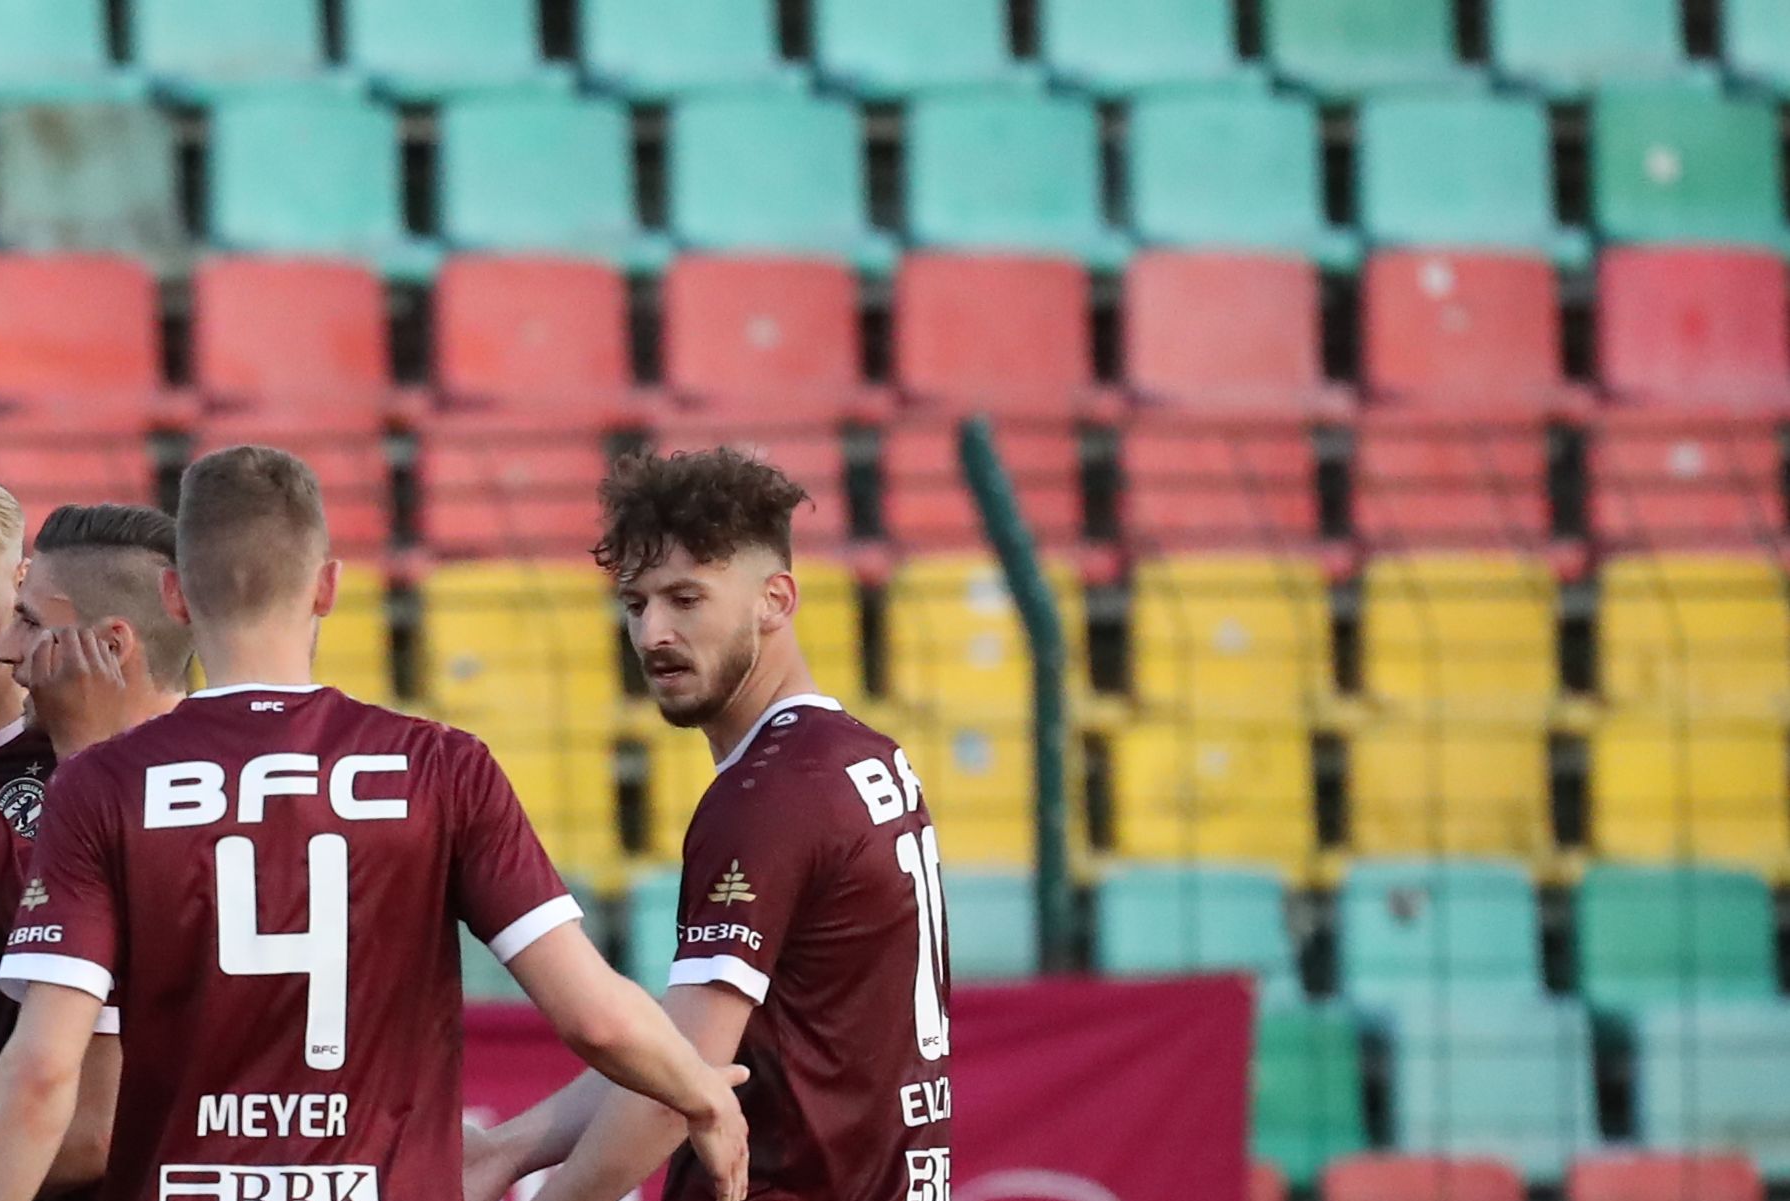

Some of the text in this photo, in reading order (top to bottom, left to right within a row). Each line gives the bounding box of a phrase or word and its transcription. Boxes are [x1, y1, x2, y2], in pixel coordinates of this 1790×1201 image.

[251, 701, 284, 712] BFC
[143, 753, 408, 829] BFC
[215, 833, 348, 1071] 4
[311, 1045, 338, 1055] BFC
[197, 1093, 348, 1137] MEYER
